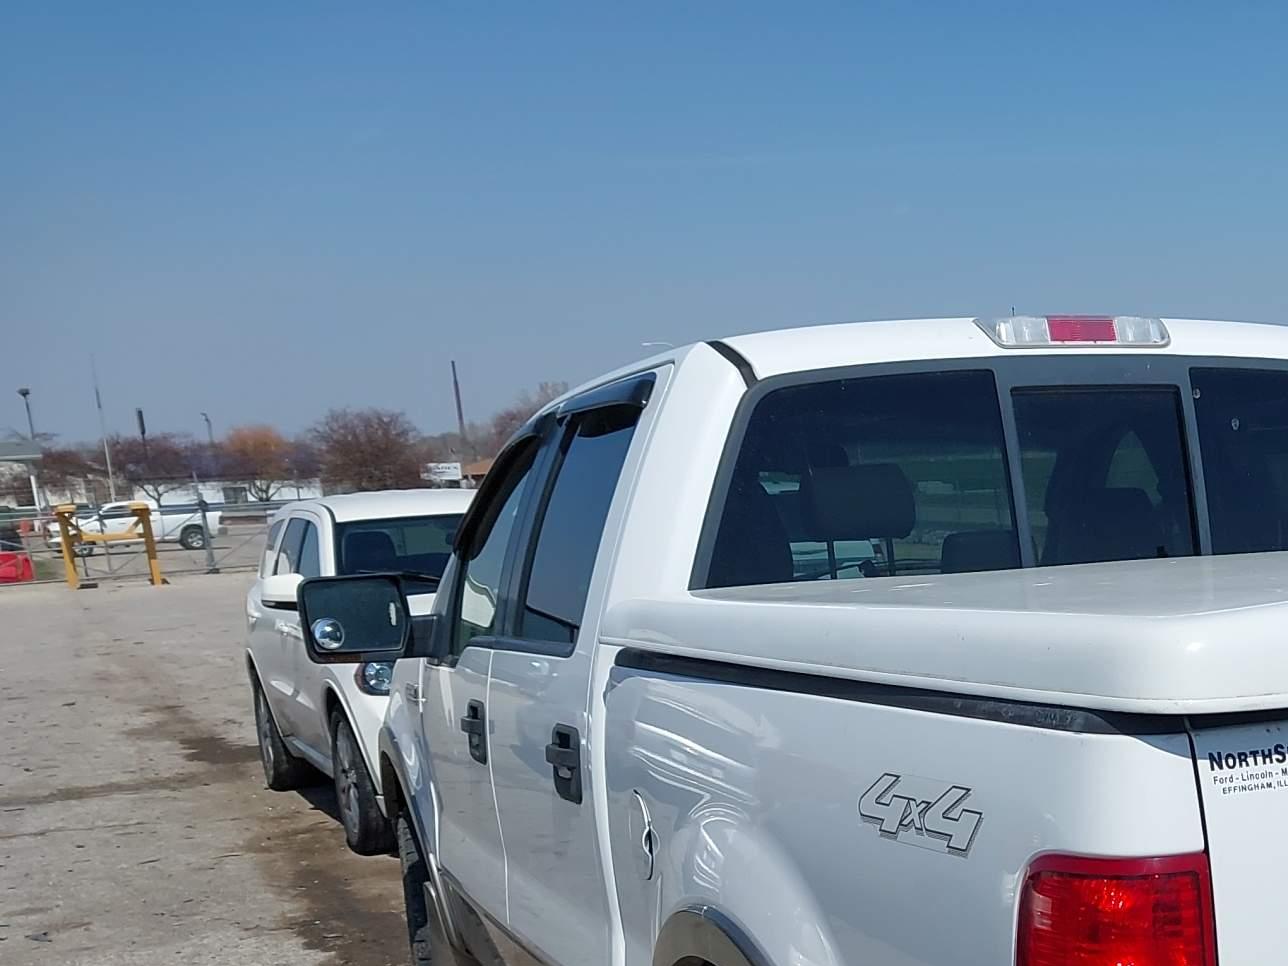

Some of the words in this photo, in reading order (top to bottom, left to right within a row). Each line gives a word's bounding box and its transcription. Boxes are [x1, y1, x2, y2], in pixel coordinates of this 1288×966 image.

[1213, 774, 1234, 785] Ford
[1241, 770, 1274, 782] Lincoln
[1222, 781, 1276, 795] EFFINGHAM,
[858, 772, 984, 859] 4x4
